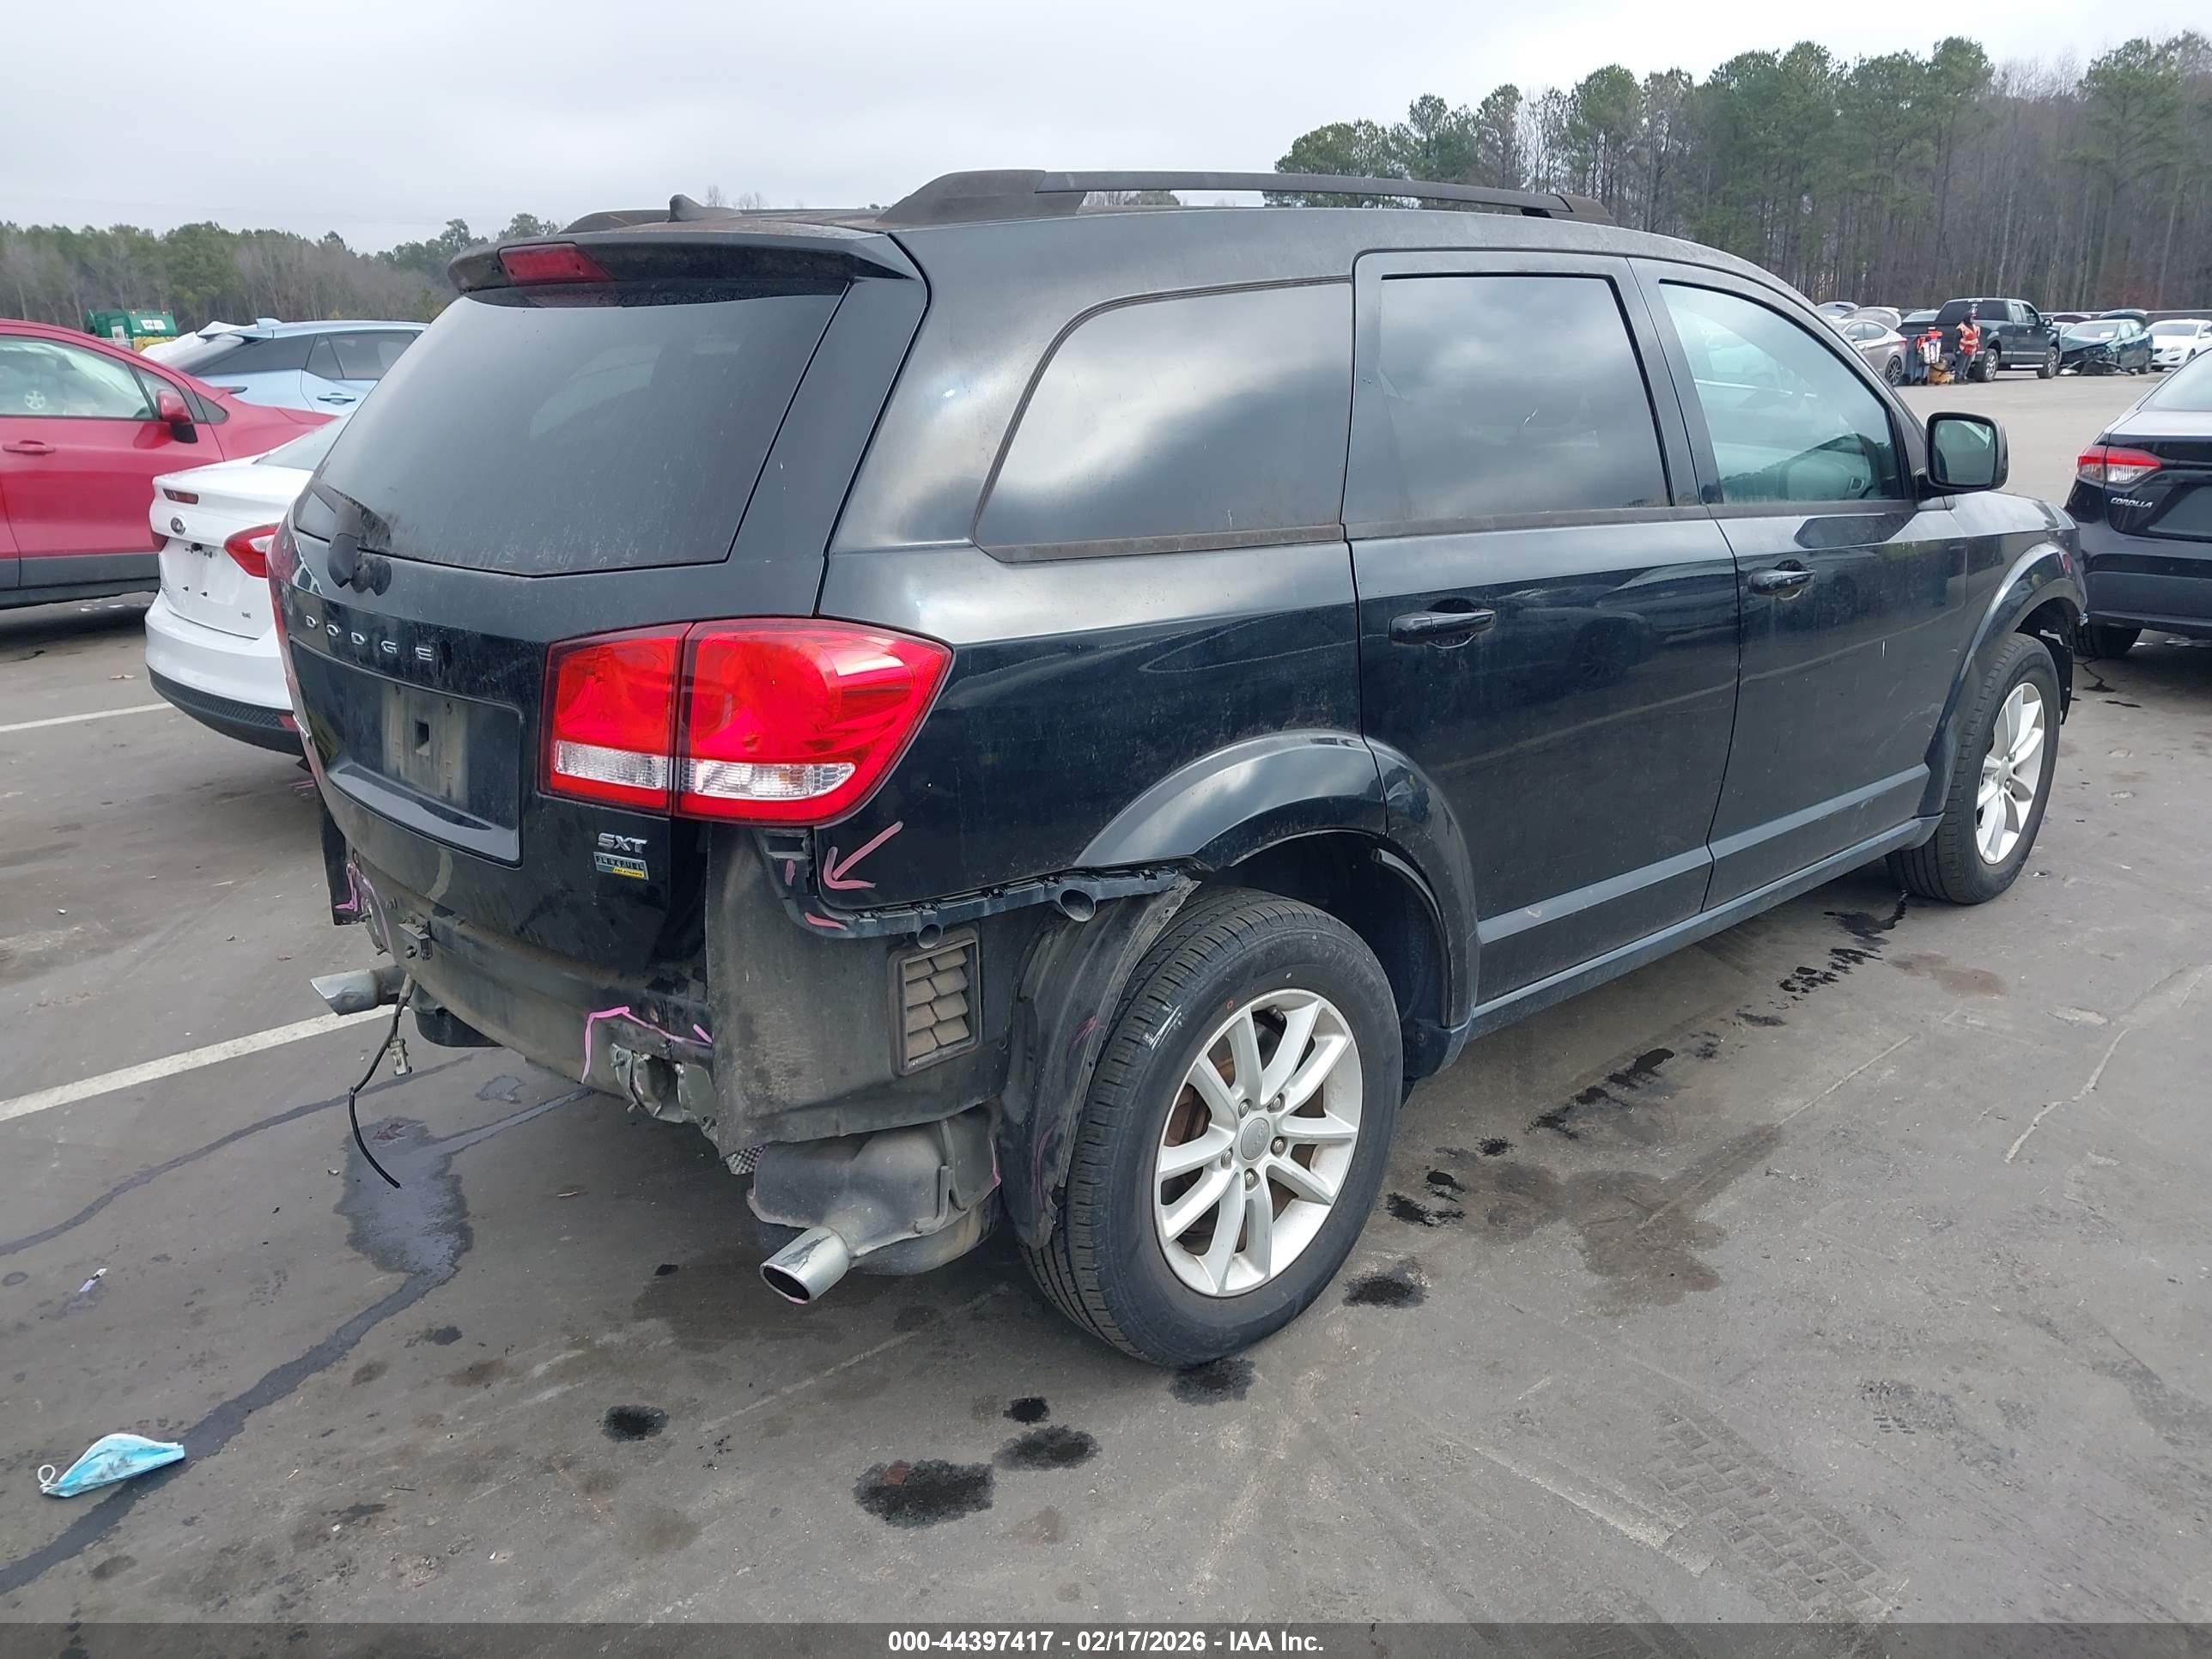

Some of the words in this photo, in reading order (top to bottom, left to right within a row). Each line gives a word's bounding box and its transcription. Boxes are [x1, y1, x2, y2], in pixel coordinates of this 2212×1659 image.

[2110, 497, 2154, 508] COROLLA
[305, 615, 433, 661] DODGE
[598, 833, 647, 854] SXT
